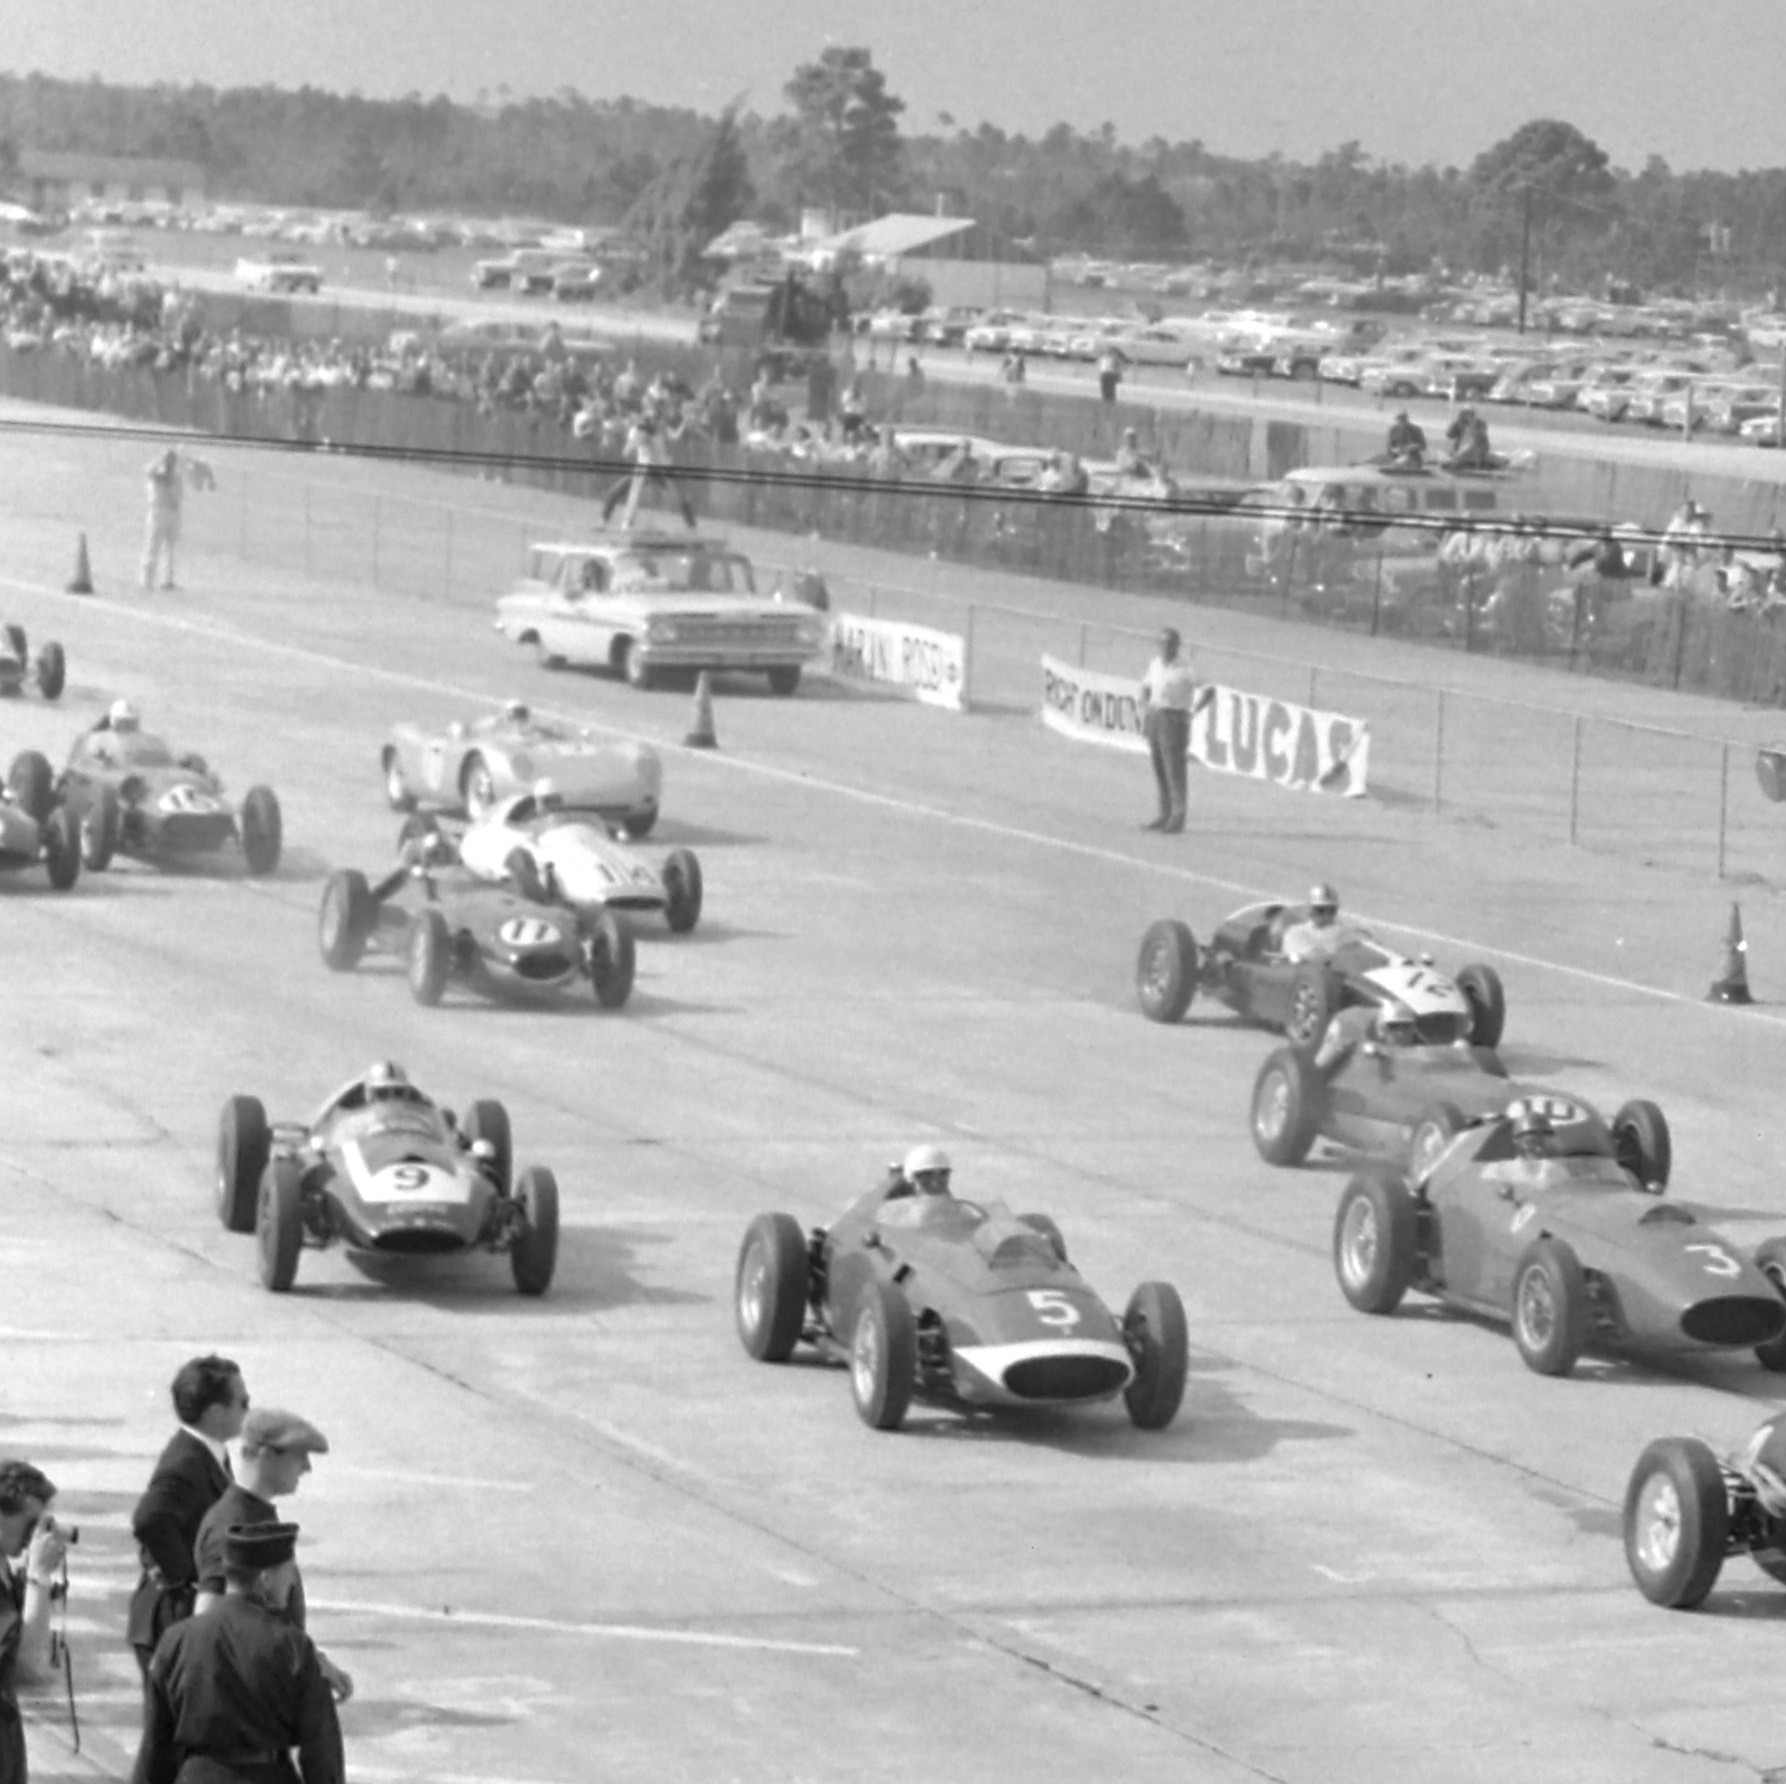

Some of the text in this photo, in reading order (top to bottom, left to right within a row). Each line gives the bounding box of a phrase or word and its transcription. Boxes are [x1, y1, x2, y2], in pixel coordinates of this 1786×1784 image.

[1204, 692, 1353, 792] LUCAS
[395, 1166, 430, 1190] 9
[1684, 1244, 1741, 1279] 3
[1026, 1290, 1080, 1325] 5
